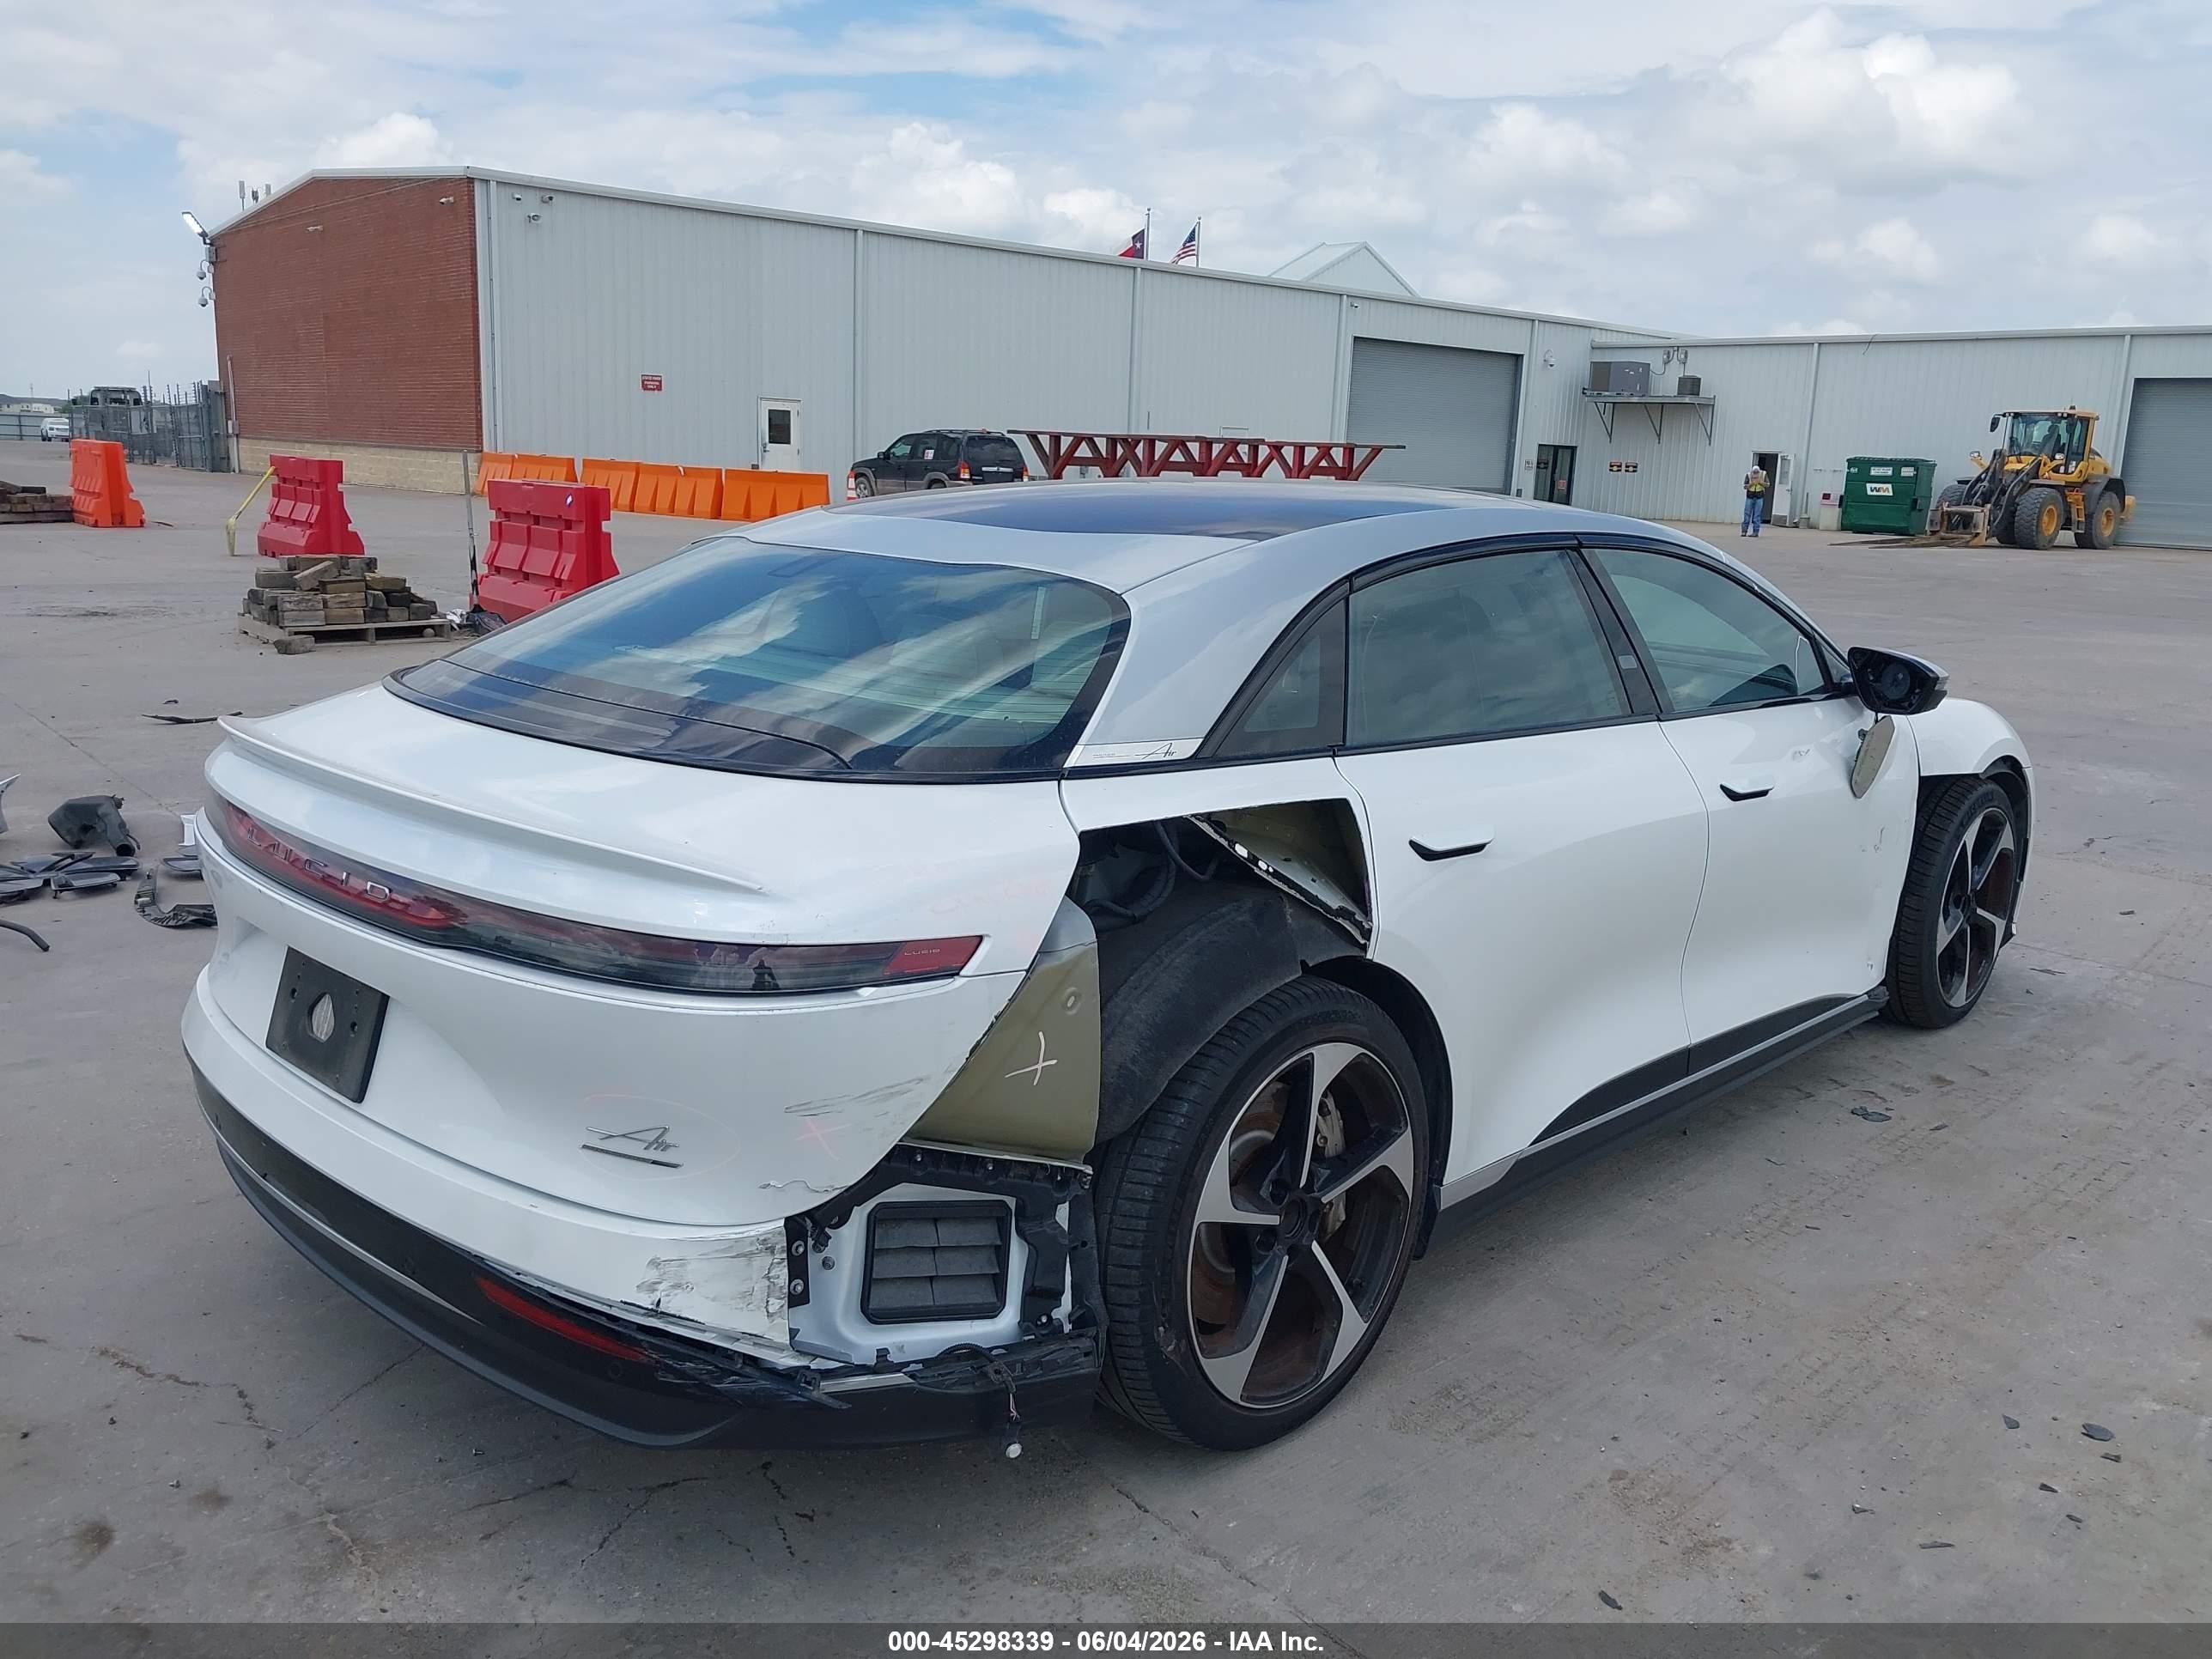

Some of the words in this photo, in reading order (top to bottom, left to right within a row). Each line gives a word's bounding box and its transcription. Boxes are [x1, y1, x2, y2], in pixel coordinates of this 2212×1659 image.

[1134, 742, 1177, 760] Air
[247, 826, 392, 902] LUCID
[586, 1125, 680, 1152] Air
